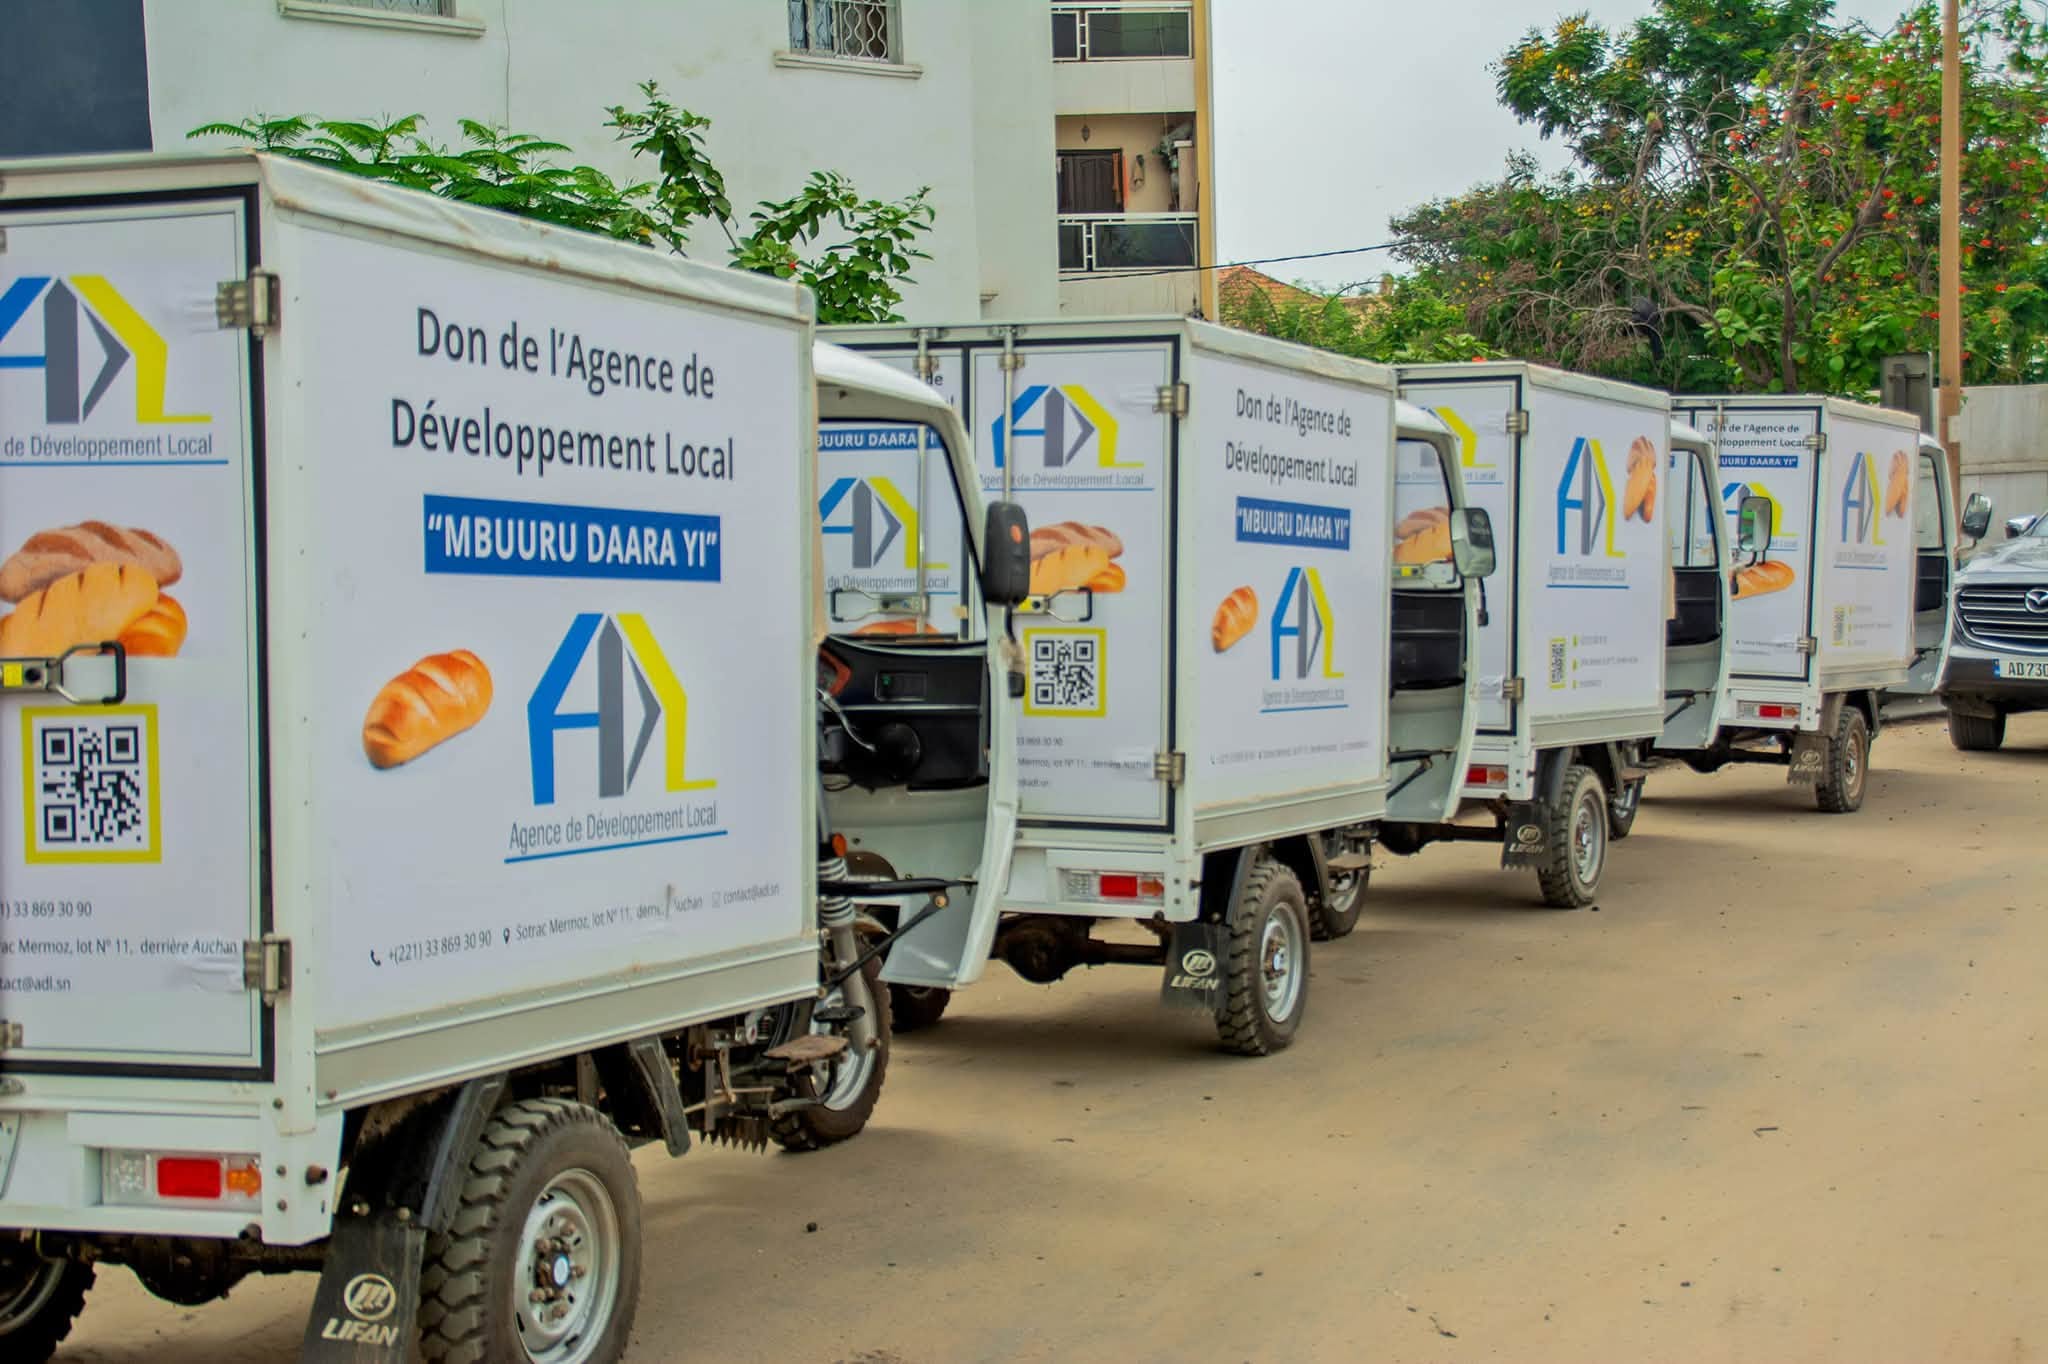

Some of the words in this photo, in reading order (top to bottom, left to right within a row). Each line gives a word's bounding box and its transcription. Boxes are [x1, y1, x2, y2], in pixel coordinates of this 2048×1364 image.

[417, 307, 487, 365] Don
[500, 321, 539, 374] de
[550, 328, 673, 396] l’Agence
[682, 353, 715, 399] de
[1236, 389, 1262, 419] Don
[1266, 394, 1281, 424] de
[1285, 398, 1334, 437] l’Agence
[1337, 410, 1351, 437] de
[391, 399, 656, 476] Développement
[665, 432, 734, 480] Local
[868, 432, 917, 447] DAARA
[1729, 424, 1741, 433] de
[1787, 424, 1799, 433] de
[4, 436, 25, 457] de
[31, 434, 162, 460] Développement
[168, 434, 212, 455] Local
[1225, 441, 1325, 485] Développement
[1328, 458, 1358, 488] Local
[427, 514, 577, 563] “MBUURU
[587, 523, 677, 567] DAARA
[682, 530, 718, 568] YI”
[1296, 513, 1332, 540] DAARA
[927, 576, 949, 589] ocal
[509, 823, 561, 855] Agence
[566, 816, 582, 842] de
[687, 801, 717, 828] Local
[14, 901, 28, 918] 33
[32, 901, 55, 918] 869
[58, 901, 74, 918] 30
[76, 901, 92, 917] 90
[18, 938, 73, 956] Mermoz,
[76, 938, 93, 955] lot
[96, 939, 111, 955] N°
[140, 939, 189, 956] derrière
[192, 939, 238, 956] Auchan
[426, 938, 438, 957] 33
[441, 935, 461, 955] 869
[464, 932, 477, 951] 30
[479, 929, 492, 948] 90
[516, 922, 546, 941] Sotrac
[592, 911, 605, 929] lot
[322, 1318, 400, 1347] LIFAN
